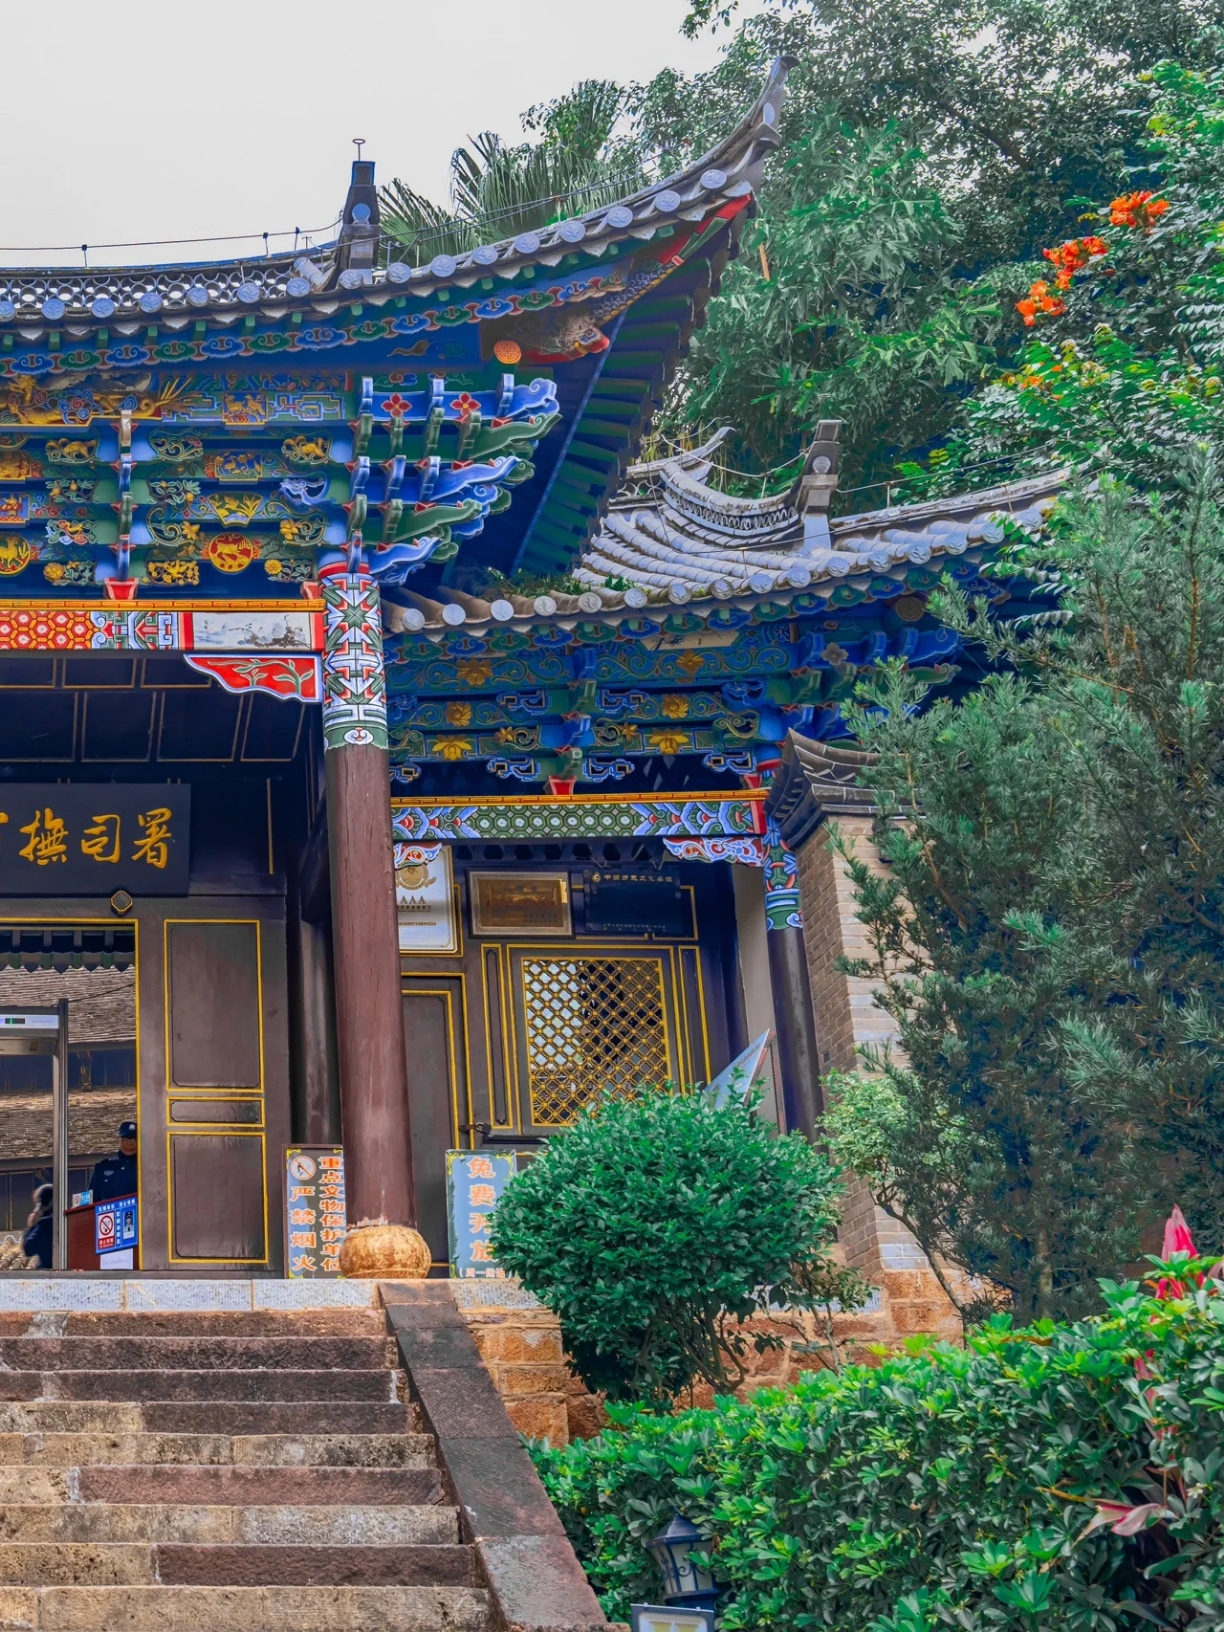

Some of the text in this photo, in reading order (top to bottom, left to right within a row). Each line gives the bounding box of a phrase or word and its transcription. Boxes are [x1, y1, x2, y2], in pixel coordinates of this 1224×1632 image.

[290, 1186, 317, 1271] 严禁烟火
[318, 1156, 346, 1271] 重点文物保护单位
